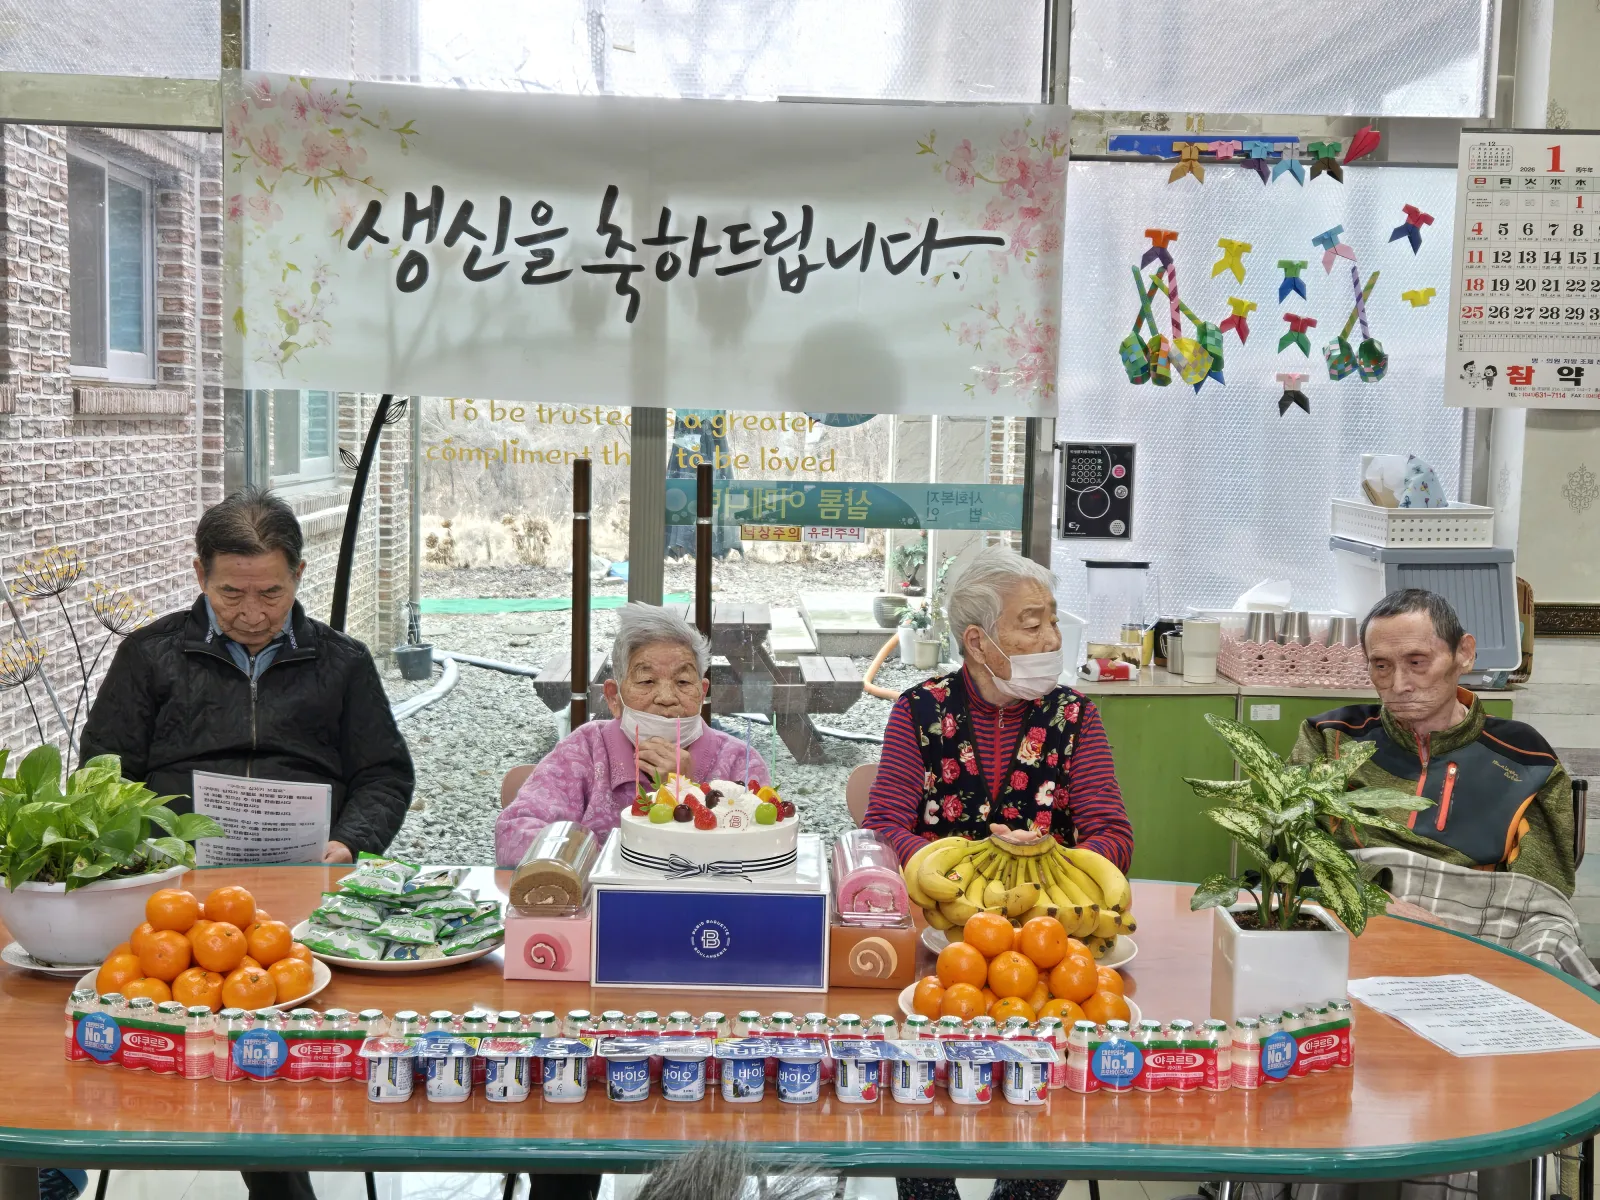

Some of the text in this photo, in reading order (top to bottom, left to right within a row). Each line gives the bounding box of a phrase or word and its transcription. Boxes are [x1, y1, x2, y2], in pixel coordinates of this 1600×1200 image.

[1546, 145, 1566, 173] 1
[1474, 177, 1587, 186] 日 月 火 水 木
[1575, 195, 1584, 208] 1
[1471, 222, 1584, 236] 4 5 6 7 8
[346, 183, 1006, 324] 생신을 축하드립니다.
[1467, 250, 1484, 263] 11
[1492, 250, 1512, 264] 12
[1518, 250, 1537, 264] 13
[1543, 251, 1562, 264] 14
[1568, 251, 1588, 264] 15
[1465, 278, 1485, 291] 18
[1491, 278, 1510, 292] 19
[1514, 278, 1536, 292] 20
[1541, 279, 1560, 292] 21
[1565, 279, 1586, 293] 22
[1461, 305, 1484, 319] 25
[1487, 306, 1510, 319] 26
[1513, 306, 1535, 319] 27
[1539, 306, 1560, 320] 28
[1564, 306, 1585, 320] 29
[1506, 365, 1585, 387] 참 약
[443, 397, 479, 422] To
[490, 399, 526, 423] be
[684, 414, 702, 429] a
[711, 411, 821, 439] greater
[675, 444, 706, 470] to
[715, 445, 750, 470] be
[760, 446, 836, 473] loved
[744, 526, 800, 541] 낙상주의
[808, 526, 860, 540] 유리주의
[701, 929, 720, 949] B
[85, 1026, 115, 1045] No.1
[130, 1035, 166, 1049] 야쿠르트
[242, 1041, 279, 1060] No.1
[299, 1045, 342, 1055] 야쿠르트
[1304, 1037, 1333, 1051] 야쿠르트
[1101, 1051, 1135, 1070] No.1
[1154, 1055, 1195, 1065] 야쿠르트
[1267, 1042, 1292, 1065] No.1
[612, 1070, 647, 1083] 바이오
